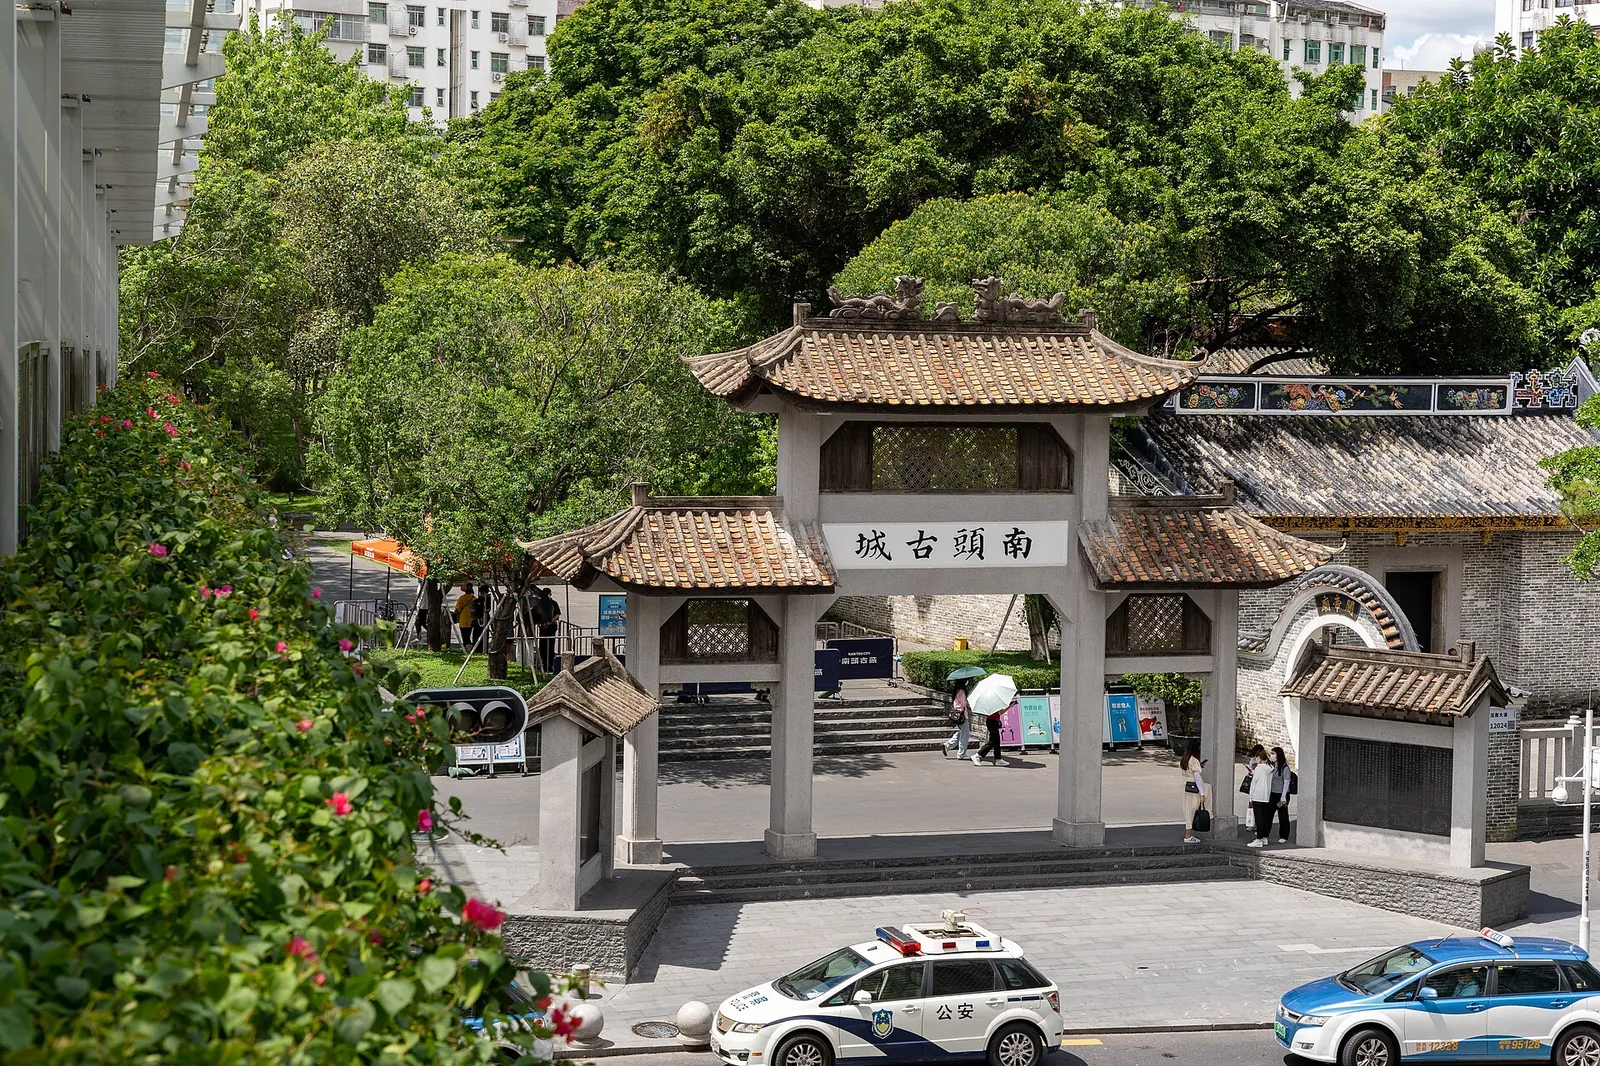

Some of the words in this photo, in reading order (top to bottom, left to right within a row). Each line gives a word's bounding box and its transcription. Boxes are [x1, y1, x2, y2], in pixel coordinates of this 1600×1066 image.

[936, 1002, 974, 1020] 公安
[1429, 1041, 1459, 1052] 12328
[1511, 1039, 1541, 1050] 95128
